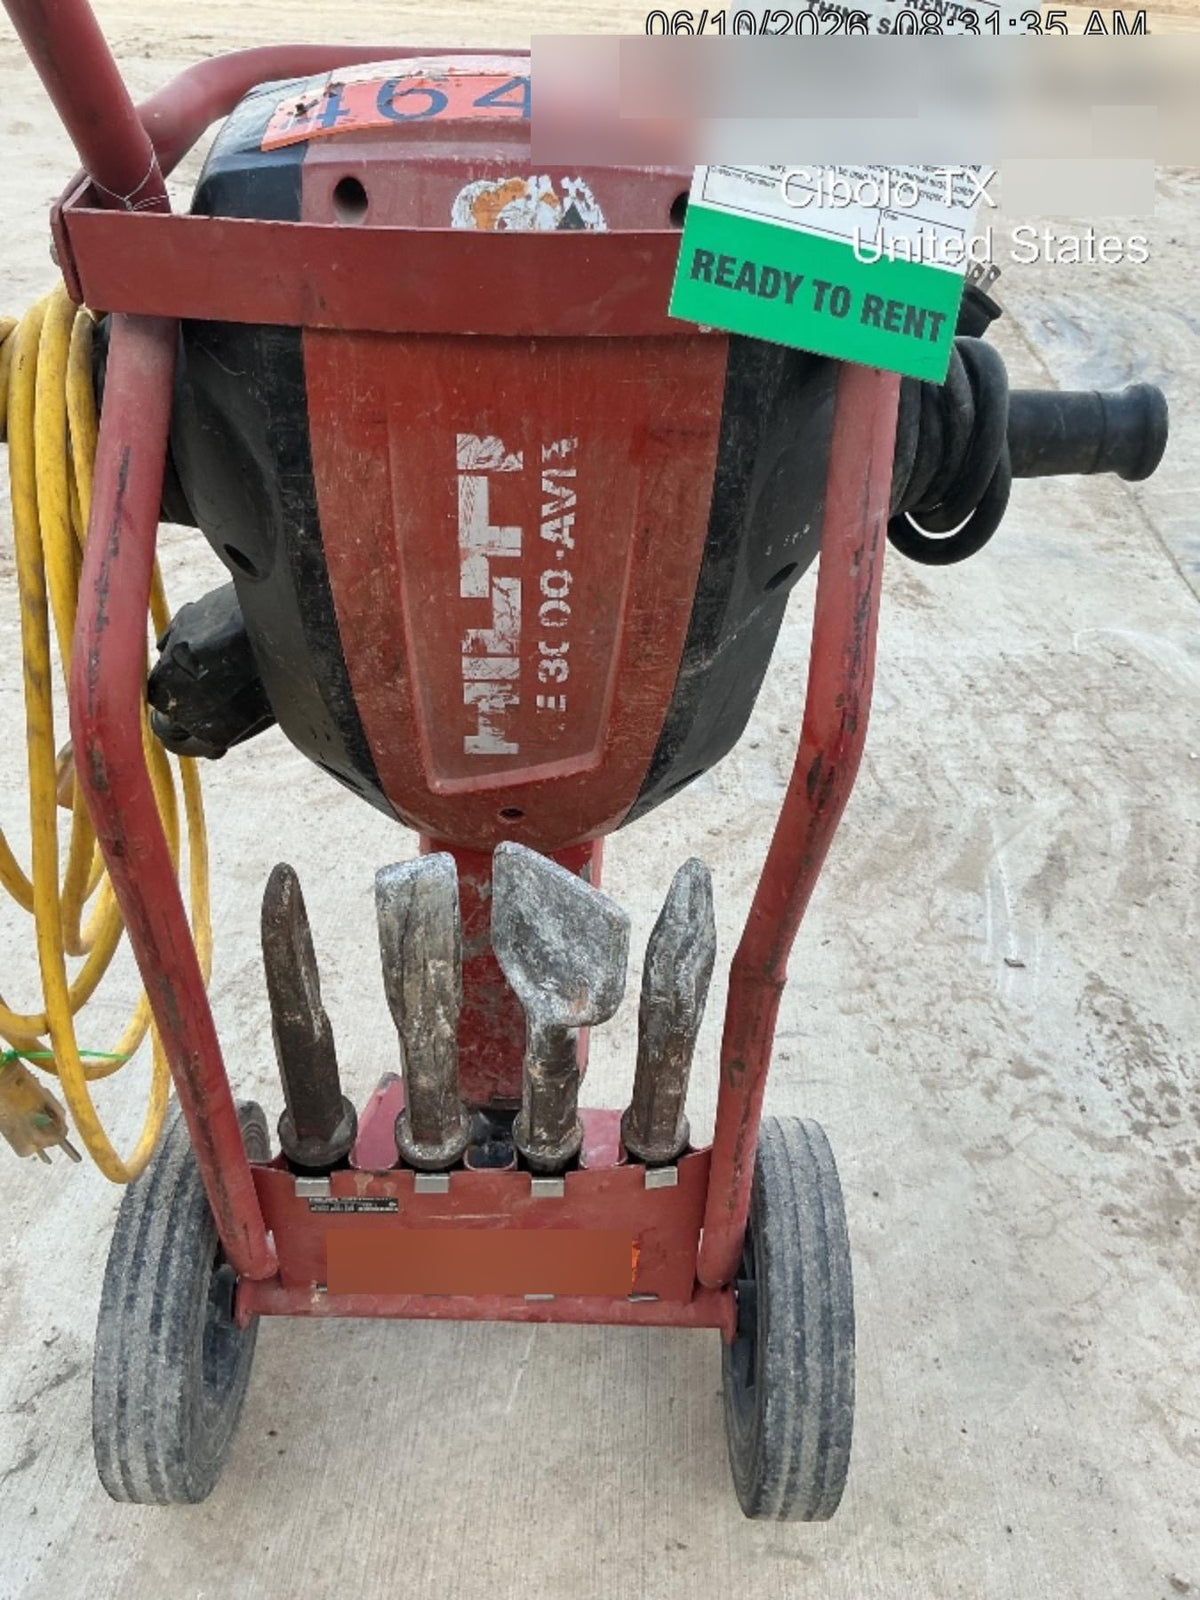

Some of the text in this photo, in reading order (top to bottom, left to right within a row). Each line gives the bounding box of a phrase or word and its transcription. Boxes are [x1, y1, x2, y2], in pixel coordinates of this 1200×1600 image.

[690, 248, 948, 342] READY TO RENT
[456, 432, 523, 755] HILTI
